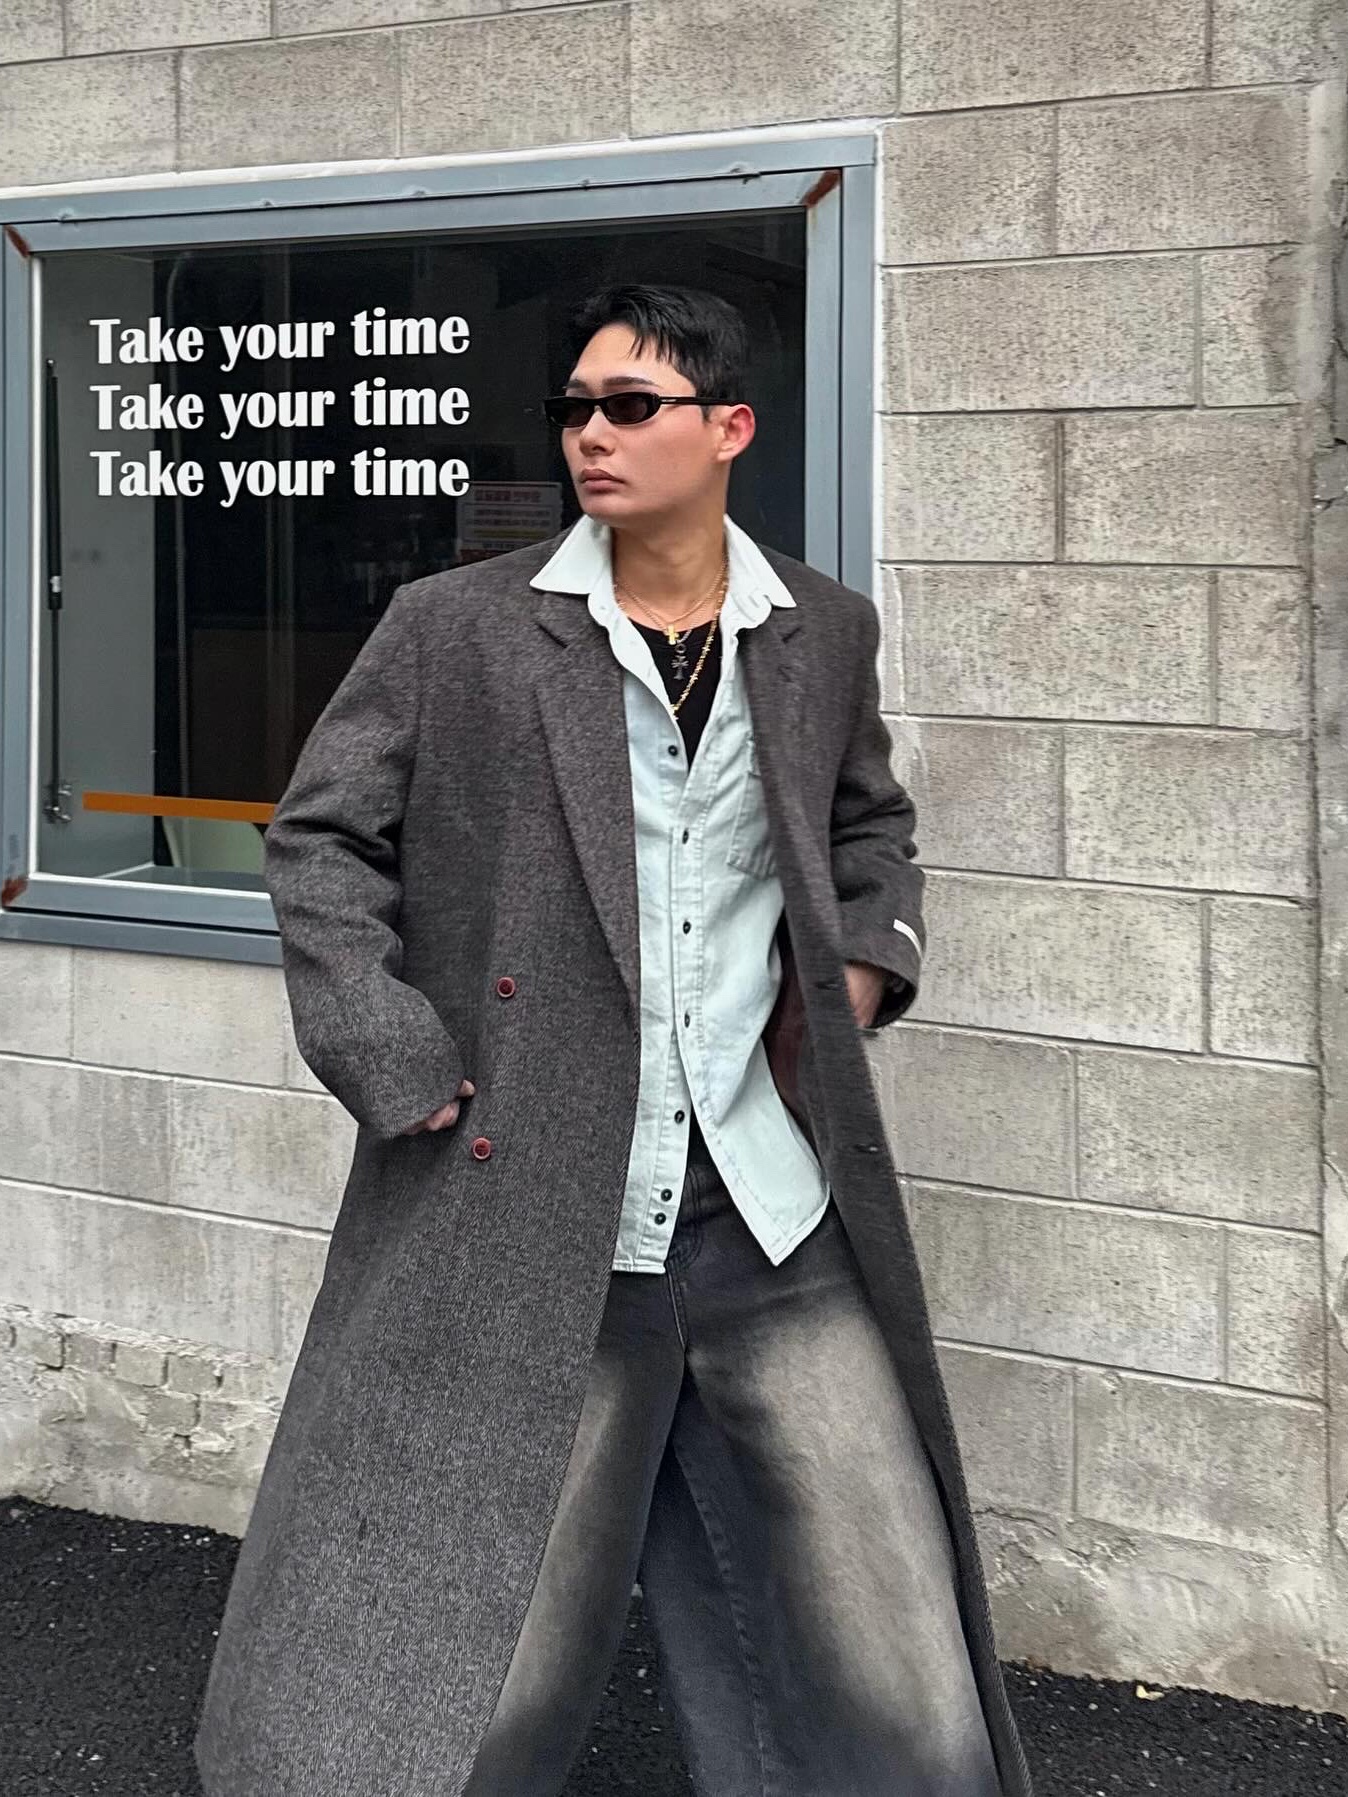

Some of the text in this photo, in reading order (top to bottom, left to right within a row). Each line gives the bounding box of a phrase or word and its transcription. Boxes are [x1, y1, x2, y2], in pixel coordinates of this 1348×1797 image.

[89, 307, 471, 373] Take your time
[89, 377, 471, 440] Take your time
[89, 447, 471, 508] Take your time
